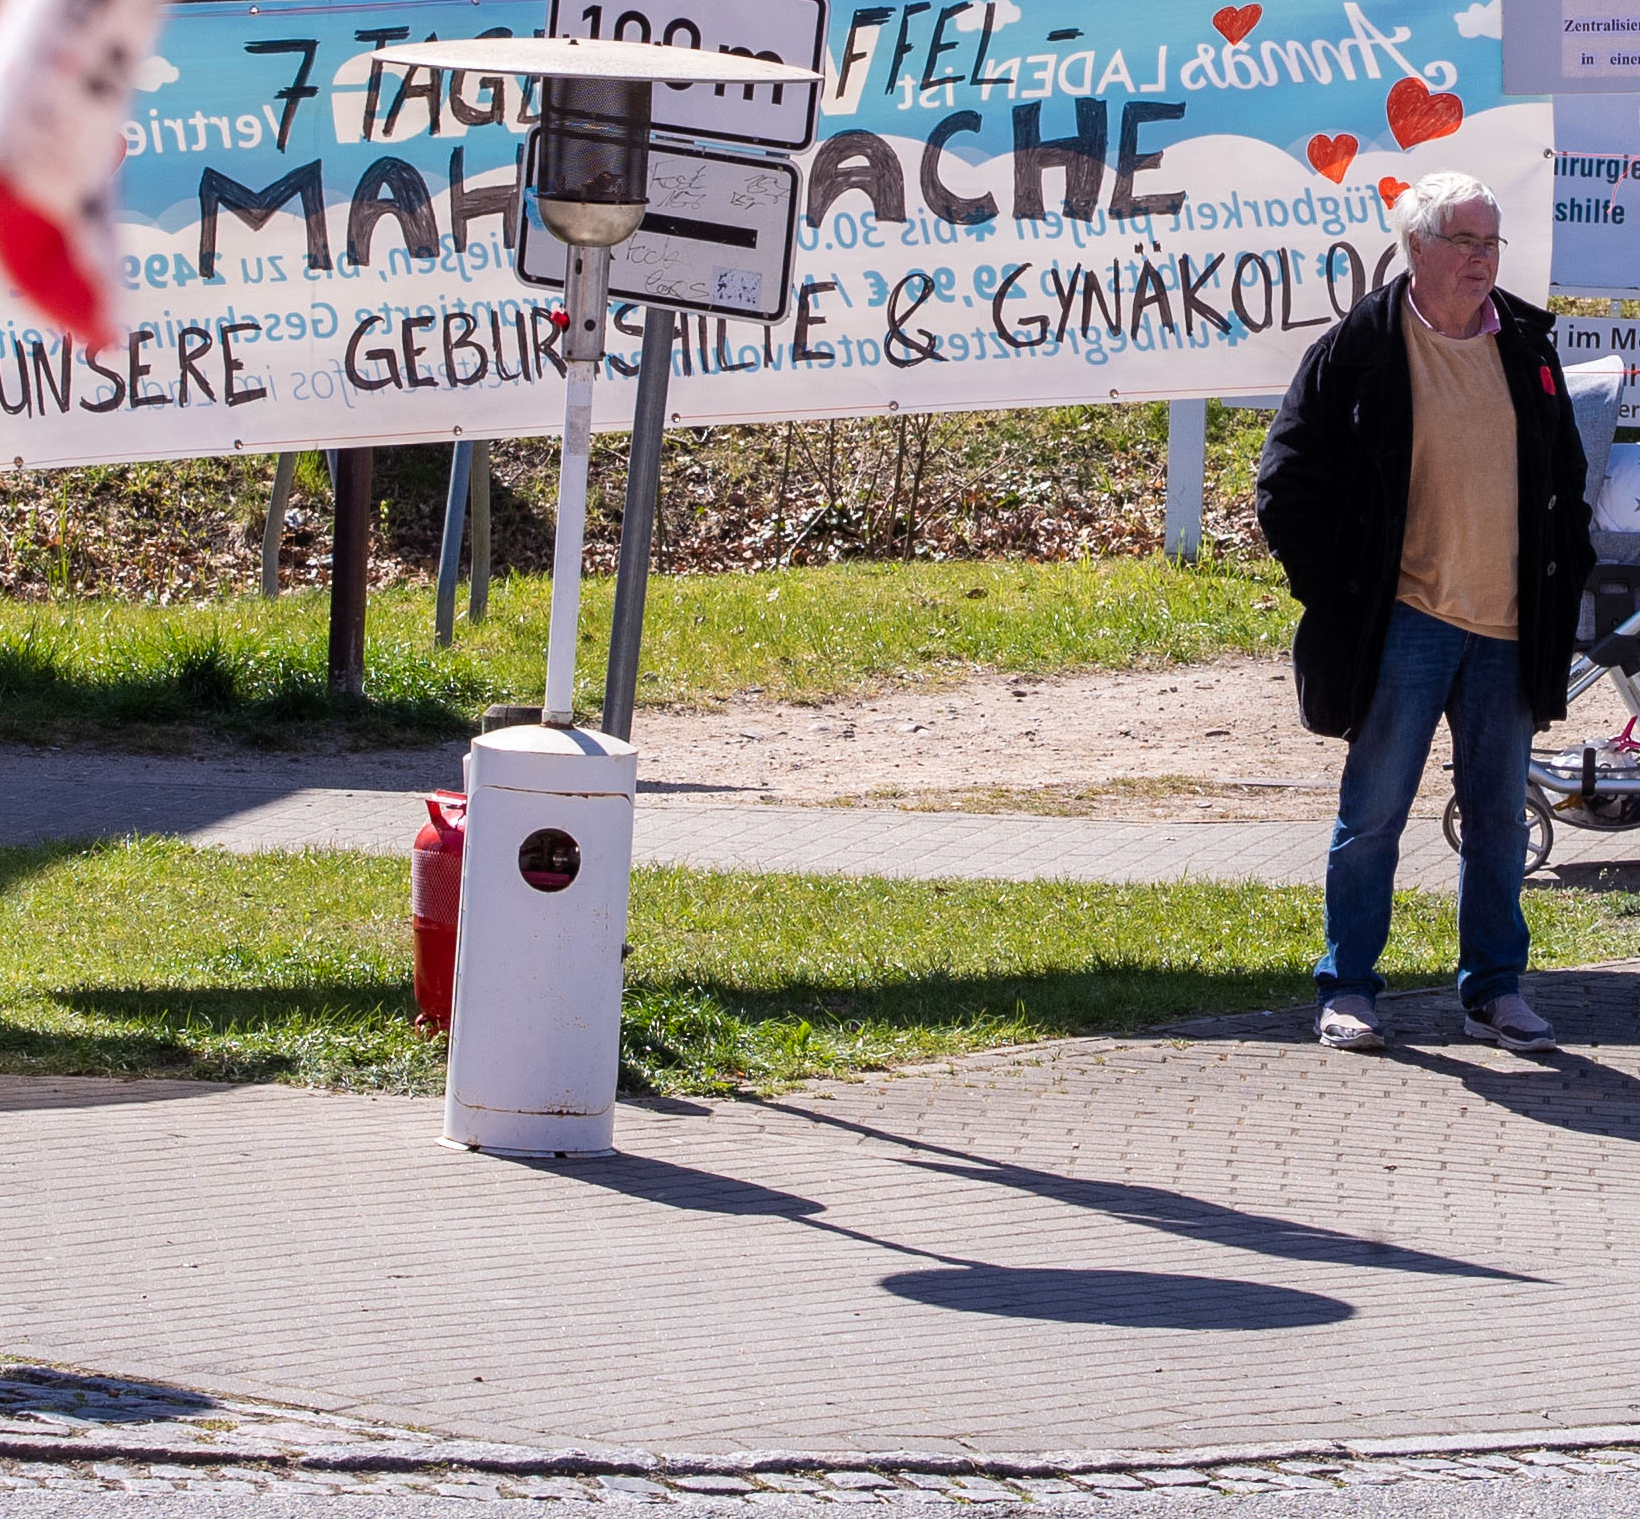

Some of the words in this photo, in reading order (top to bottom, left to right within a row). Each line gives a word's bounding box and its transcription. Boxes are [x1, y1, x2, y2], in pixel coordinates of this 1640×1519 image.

[1581, 52, 1594, 65] in
[244, 38, 320, 154] 7
[1554, 197, 1625, 224] shilfe
[884, 273, 949, 369] &
[1568, 325, 1600, 349] im
